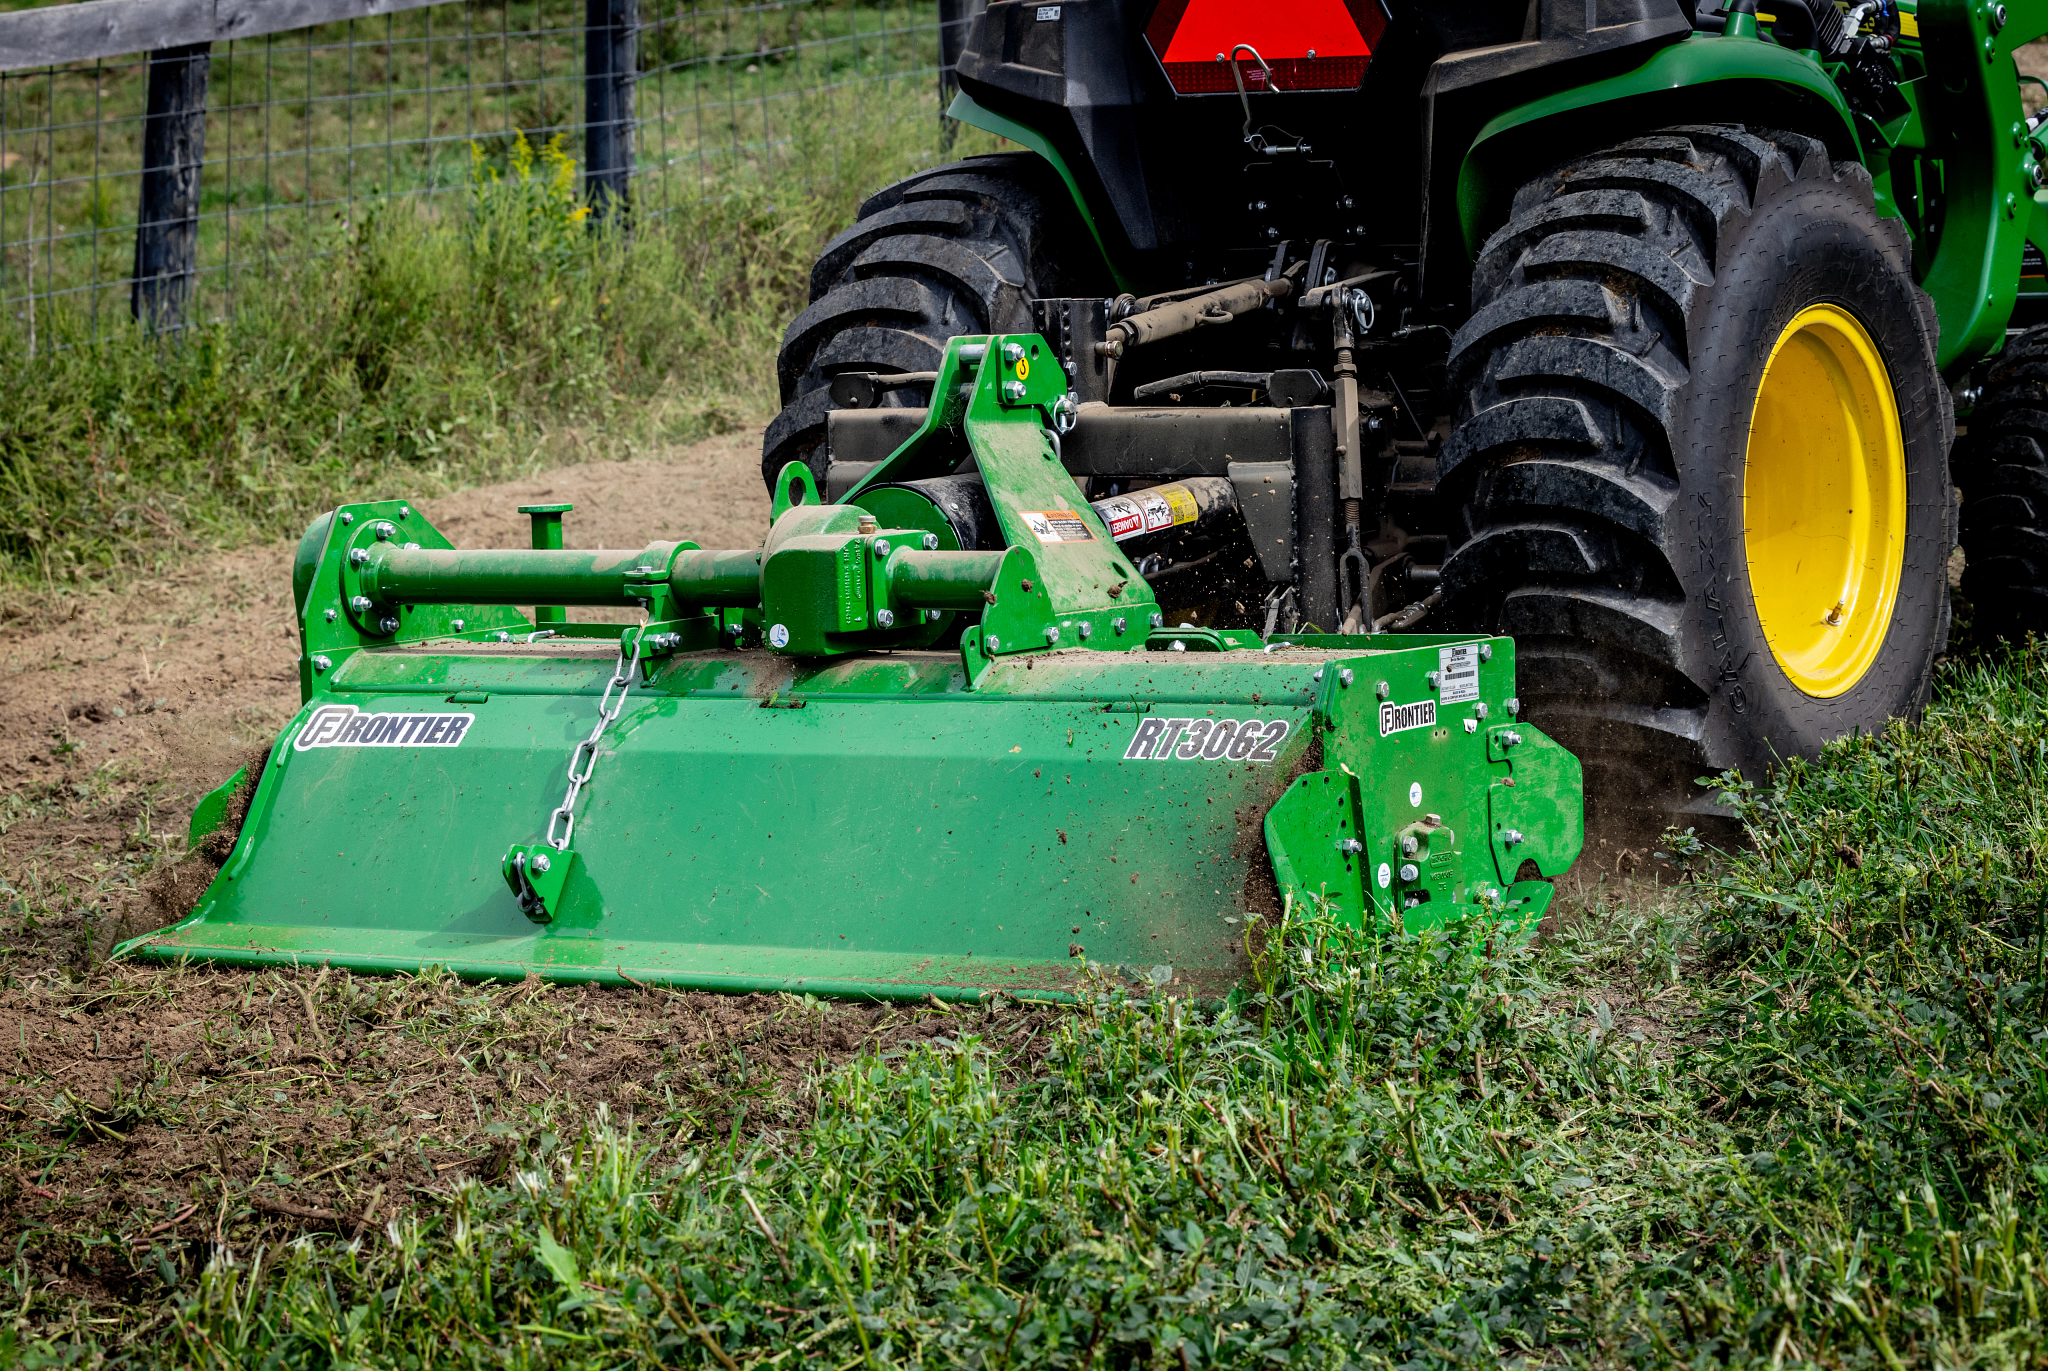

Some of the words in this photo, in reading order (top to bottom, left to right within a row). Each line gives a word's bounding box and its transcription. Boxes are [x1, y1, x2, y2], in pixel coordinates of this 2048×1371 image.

[1110, 519, 1134, 533] DANGER
[1697, 491, 1746, 715] GALAXY
[297, 706, 471, 748] FRONTIER
[1380, 701, 1435, 735] FRONTIER
[1124, 718, 1289, 761] RT3062
